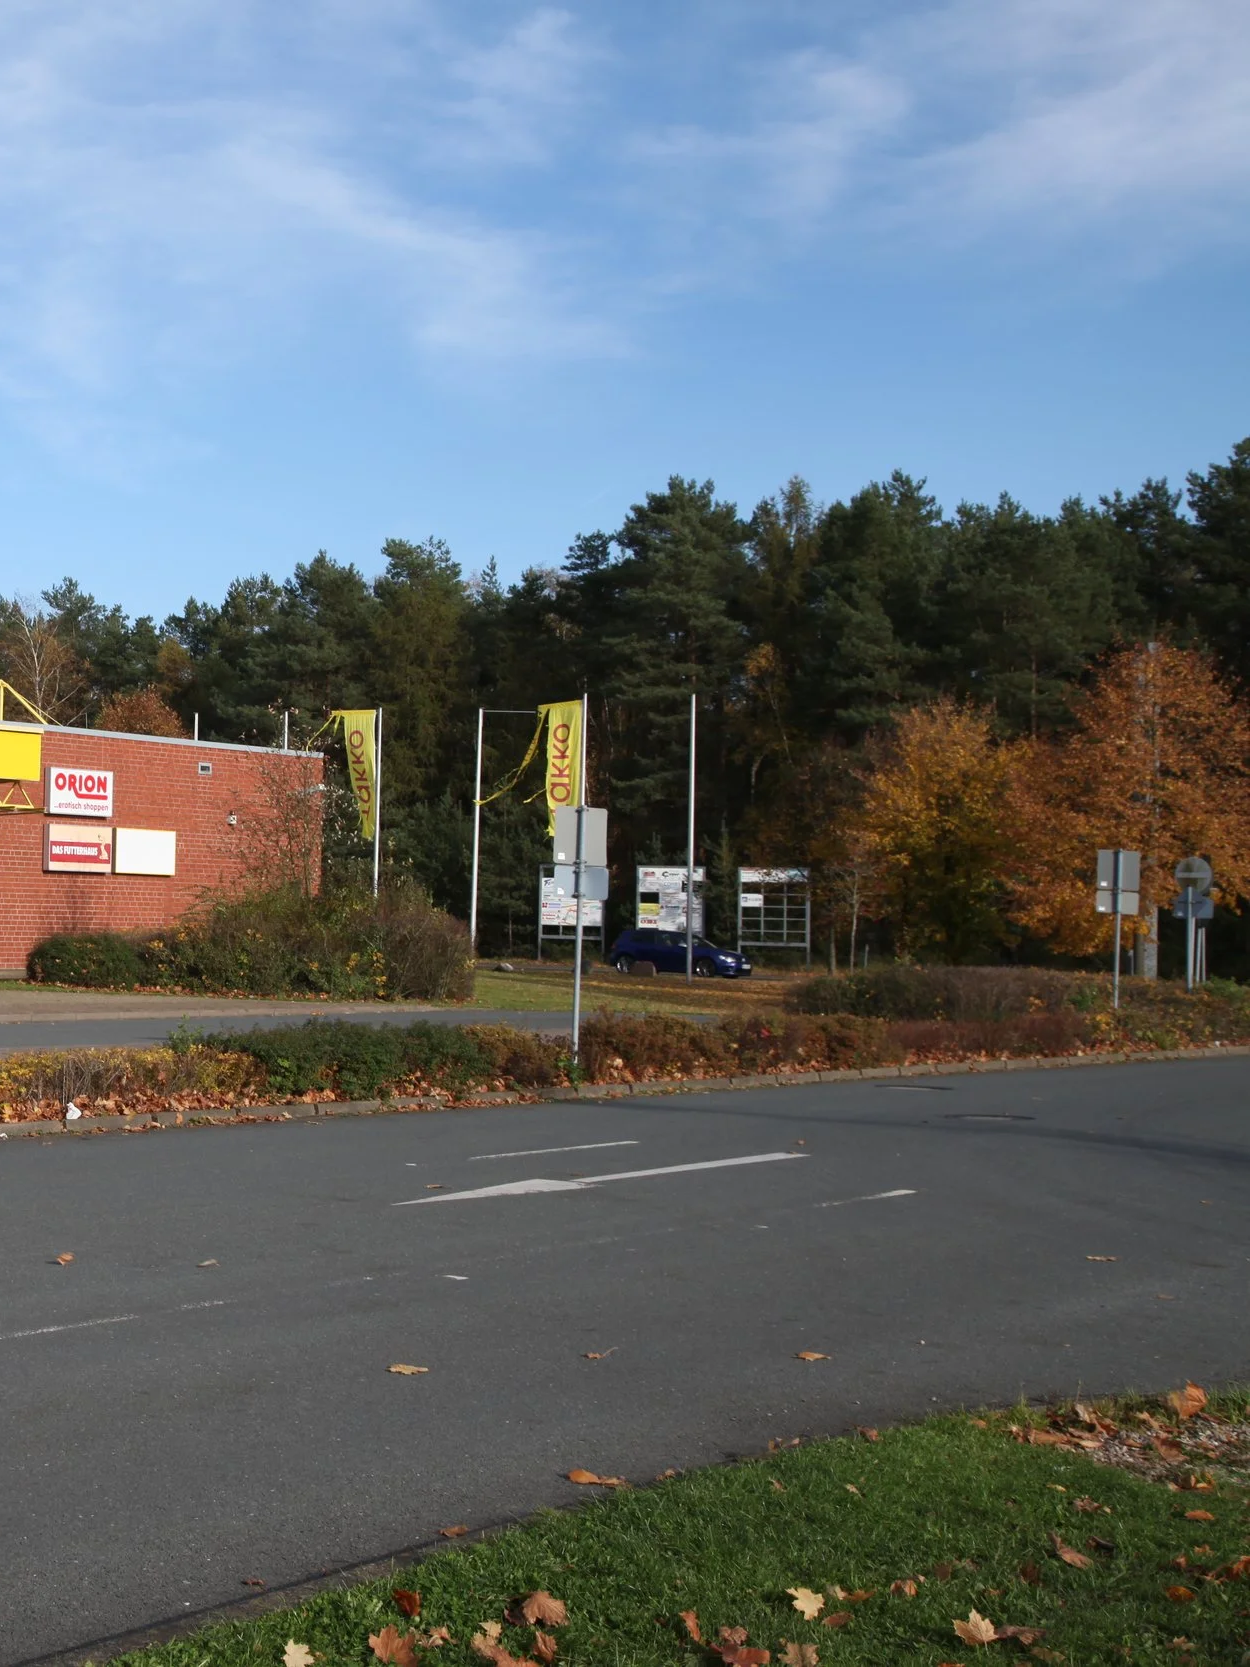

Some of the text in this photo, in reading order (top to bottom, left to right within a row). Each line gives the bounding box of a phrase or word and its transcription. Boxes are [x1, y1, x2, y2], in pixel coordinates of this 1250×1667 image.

[55, 772, 108, 800] ORION
[84, 802, 108, 812] shoppen
[52, 845, 98, 856] DAS FUTTERHAUS
